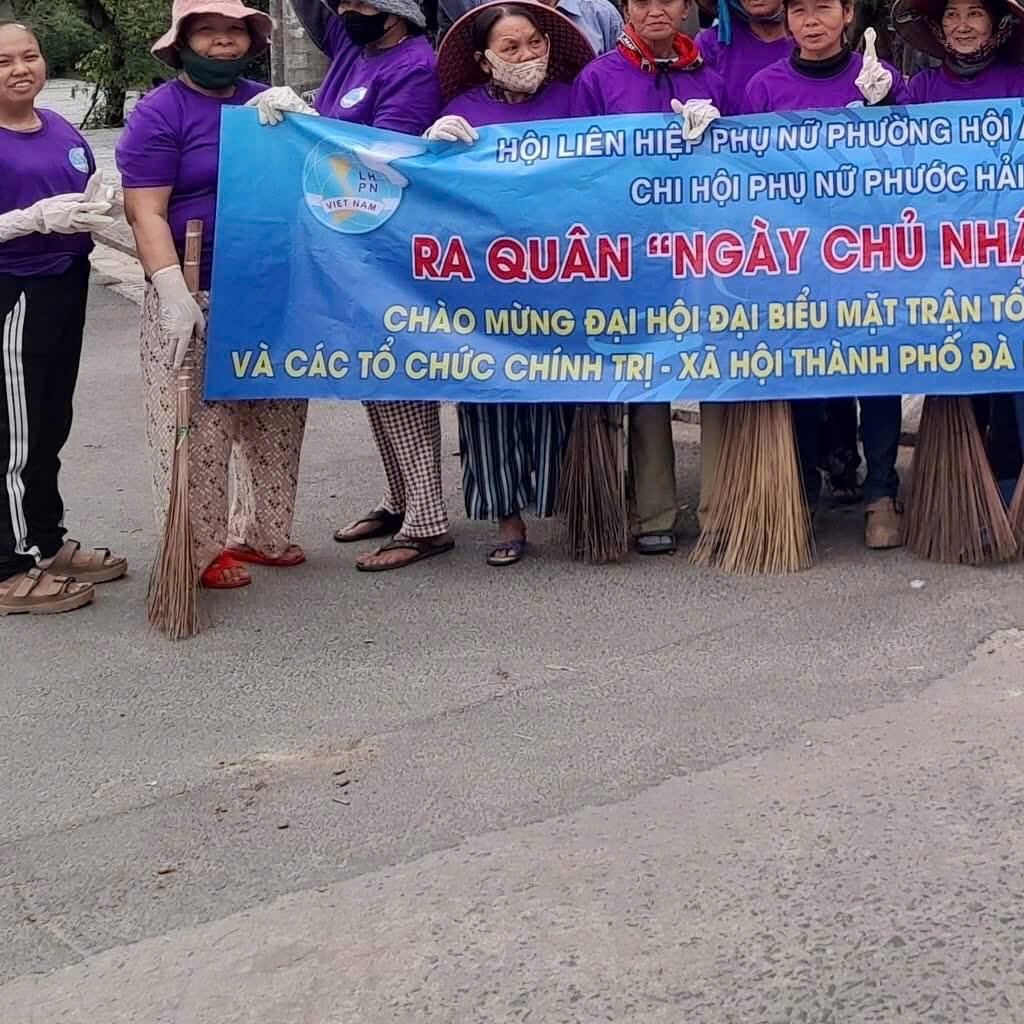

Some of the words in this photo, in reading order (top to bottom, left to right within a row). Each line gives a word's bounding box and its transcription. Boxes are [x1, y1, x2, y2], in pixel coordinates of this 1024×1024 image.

[497, 129, 548, 165] HỘI
[557, 125, 626, 158] LIÊN
[712, 126, 770, 157] PHỤ
[777, 119, 821, 151] NỮ
[827, 113, 951, 149] PHƯỜNG
[960, 109, 1011, 148] HỘI
[326, 199, 349, 210] VIET
[352, 199, 377, 212] NAM
[358, 183, 378, 193] PN
[630, 177, 682, 206] CHI
[691, 168, 740, 207] HỘI
[747, 173, 806, 205] PHỤ
[815, 165, 857, 198] NỮ
[863, 159, 968, 196] PHƯỚC
[975, 153, 1024, 192] HẢI
[412, 234, 475, 280] RA
[486, 223, 633, 283] QUÂN
[821, 207, 927, 274] CHỦ
[383, 299, 476, 335] CHÀO
[485, 301, 576, 336] MỪNG
[584, 306, 637, 343] ĐẠI
[648, 297, 700, 342] HỘI
[708, 302, 759, 339] ĐẠI
[768, 285, 828, 331] BIỂU
[837, 292, 898, 336] MẶT
[905, 288, 981, 333] TRẬN
[231, 342, 274, 379] VÀ
[284, 342, 350, 379] CÁC
[358, 336, 397, 380] TỔ
[405, 345, 495, 381] CHỨC
[504, 345, 601, 382] CHÍNH
[612, 353, 653, 388] TRỊ
[677, 345, 721, 381] XÃ
[730, 341, 783, 386] HỘI
[791, 339, 889, 377] THÀNH
[900, 331, 963, 373] PHỐ
[971, 333, 1015, 371] ĐÀ
